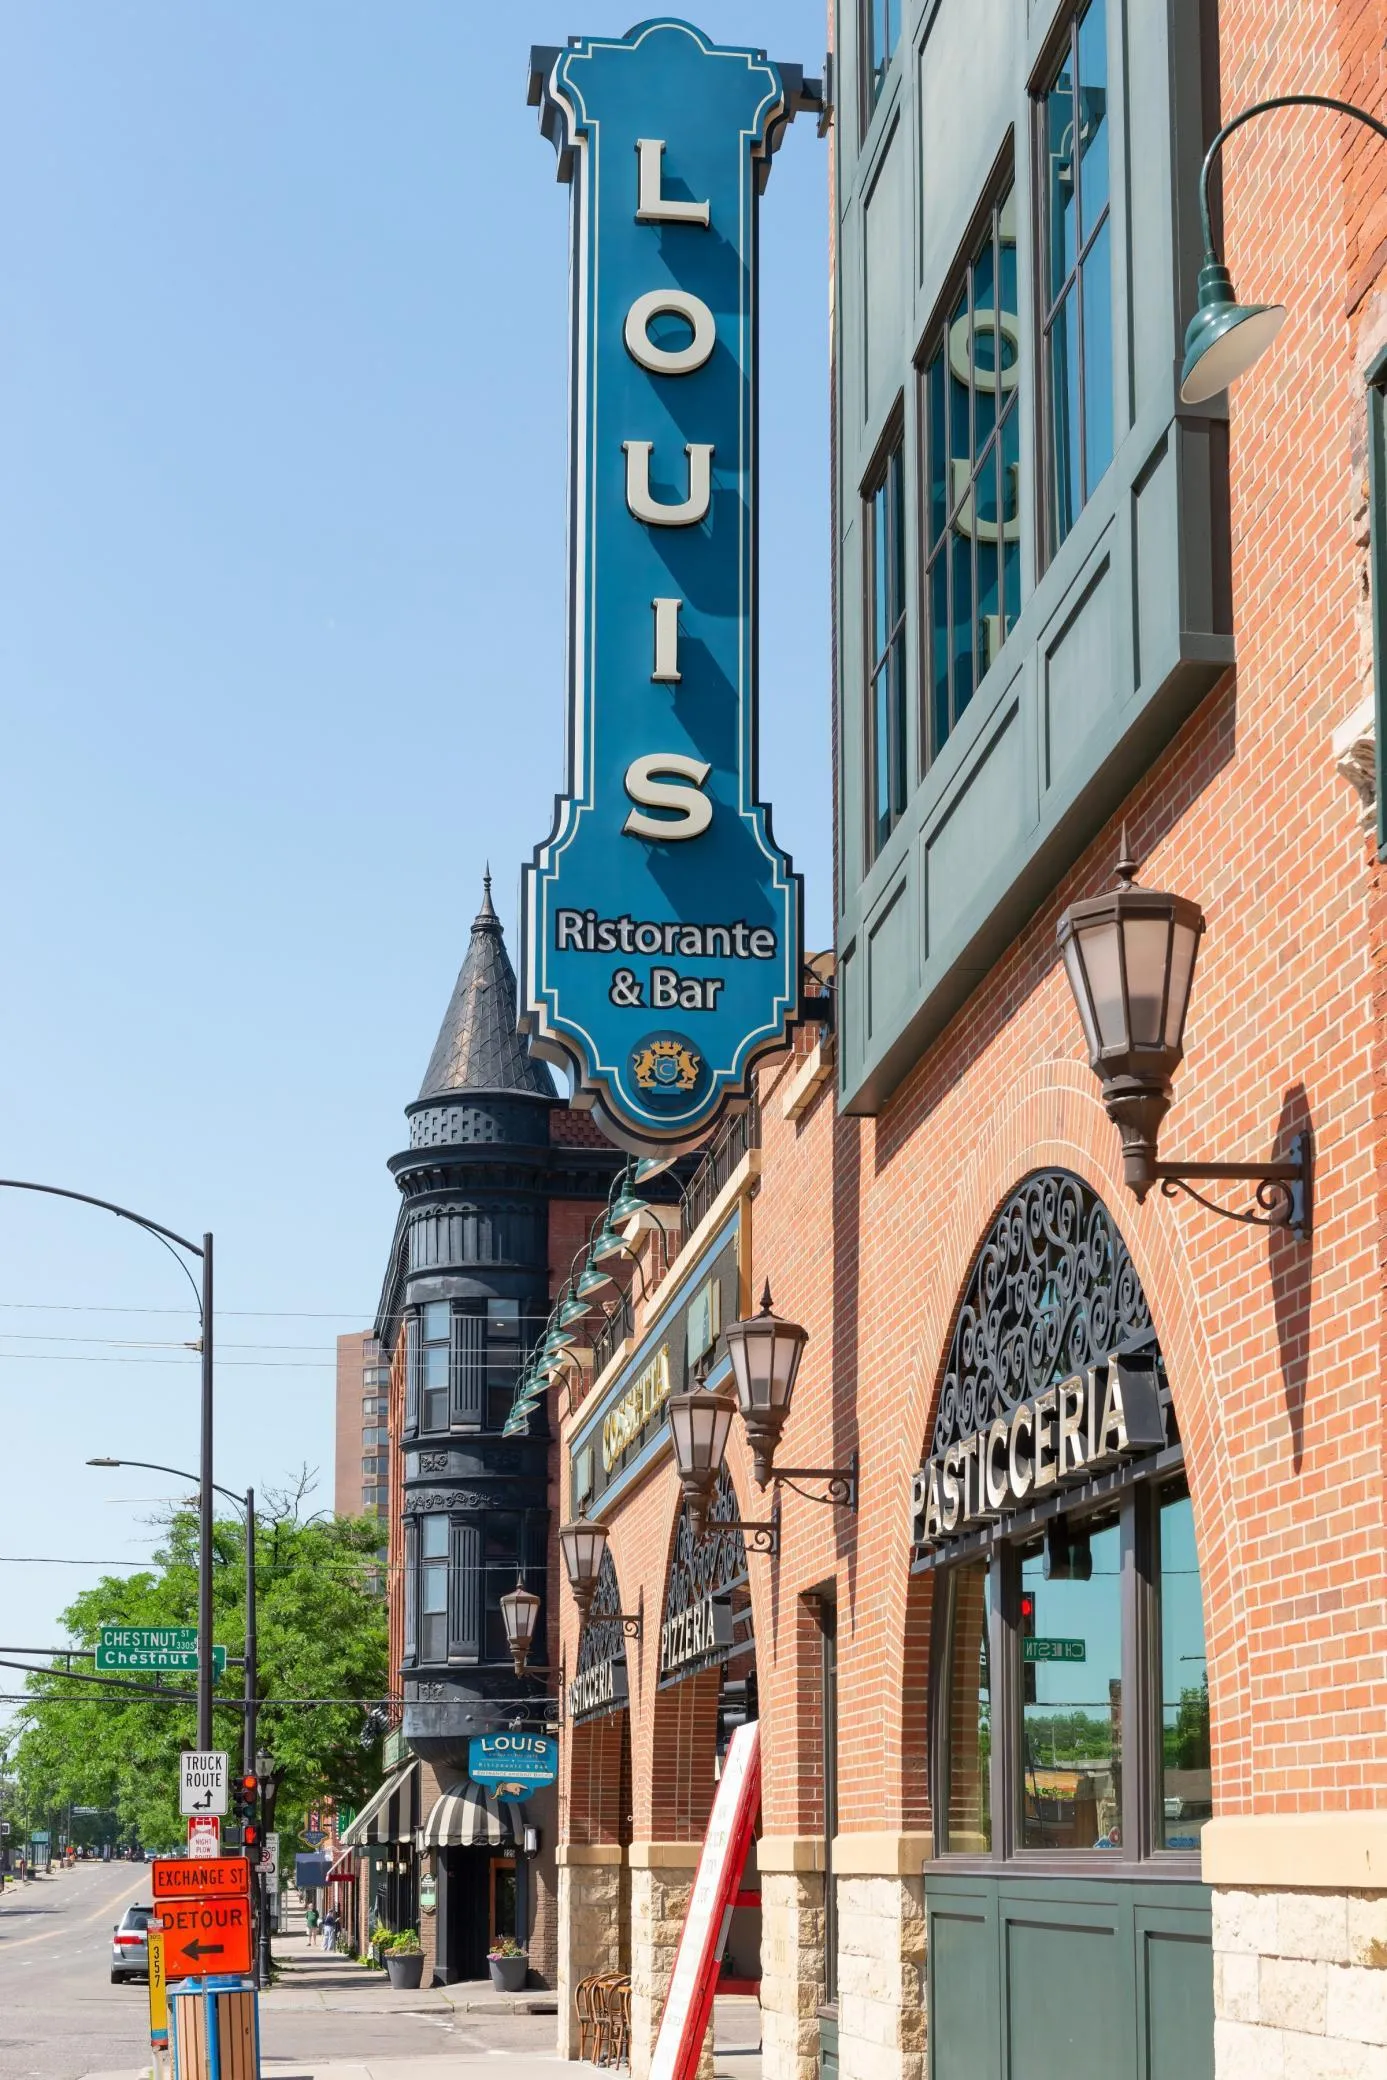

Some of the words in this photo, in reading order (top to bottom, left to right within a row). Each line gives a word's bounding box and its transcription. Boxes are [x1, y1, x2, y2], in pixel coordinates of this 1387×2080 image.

[622, 138, 716, 840] LOUIS
[556, 909, 776, 959] Ristorante
[610, 969, 643, 1006] &
[652, 968, 722, 1010] Bar
[910, 1352, 1130, 1544] PASTICCERIA
[104, 1631, 177, 1647] CHESTNUT
[181, 1629, 190, 1637] ST
[661, 1594, 715, 1672] PIZZERIA
[105, 1651, 188, 1665] Chestnut
[481, 1736, 547, 1754] LOUIS
[186, 1756, 222, 1771] TRUCK
[186, 1773, 222, 1787] ROUTE
[158, 1868, 225, 1887] EXCHANGE
[230, 1868, 244, 1884] ST
[162, 1908, 243, 1930] DETOUR
